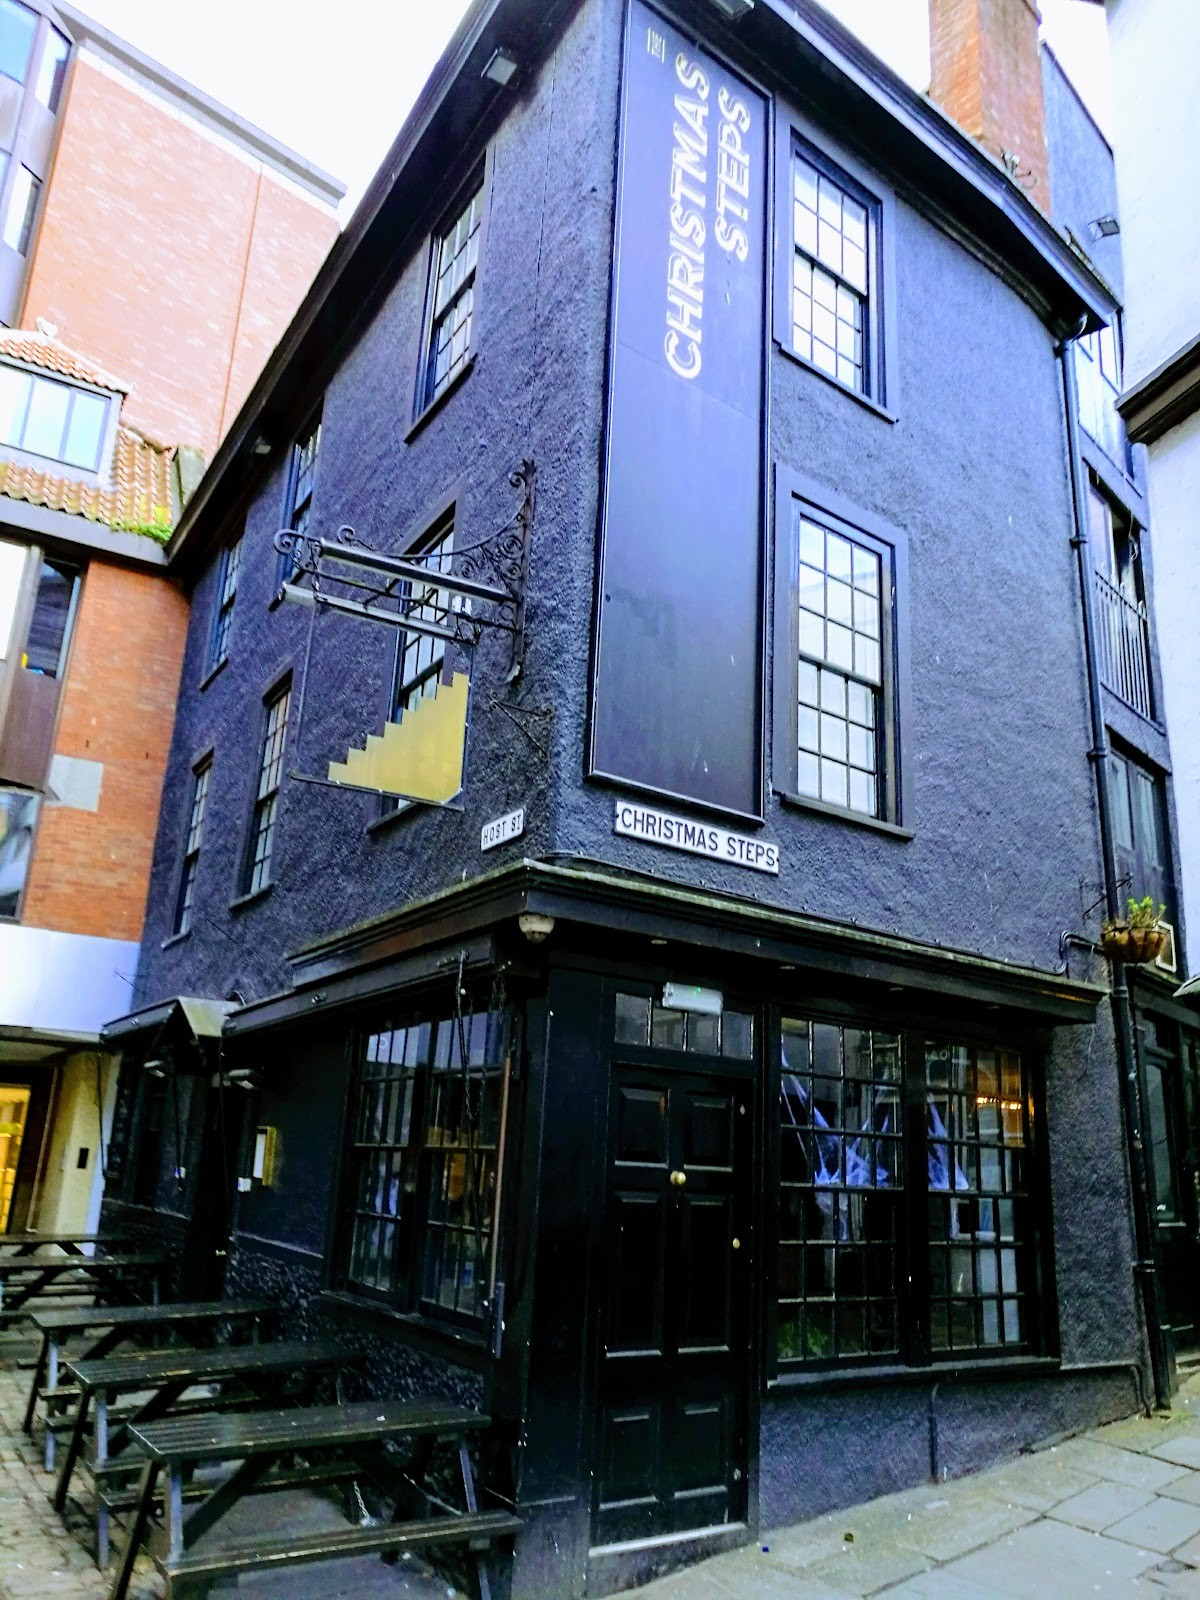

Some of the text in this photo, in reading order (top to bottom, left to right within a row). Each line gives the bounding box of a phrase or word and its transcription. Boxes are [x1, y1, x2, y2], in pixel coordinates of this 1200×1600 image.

[664, 52, 710, 379] CHRISTMAS
[714, 86, 751, 263] STEPS
[483, 820, 506, 846] HOST
[621, 808, 777, 867] CHRISTMAS STEPS
